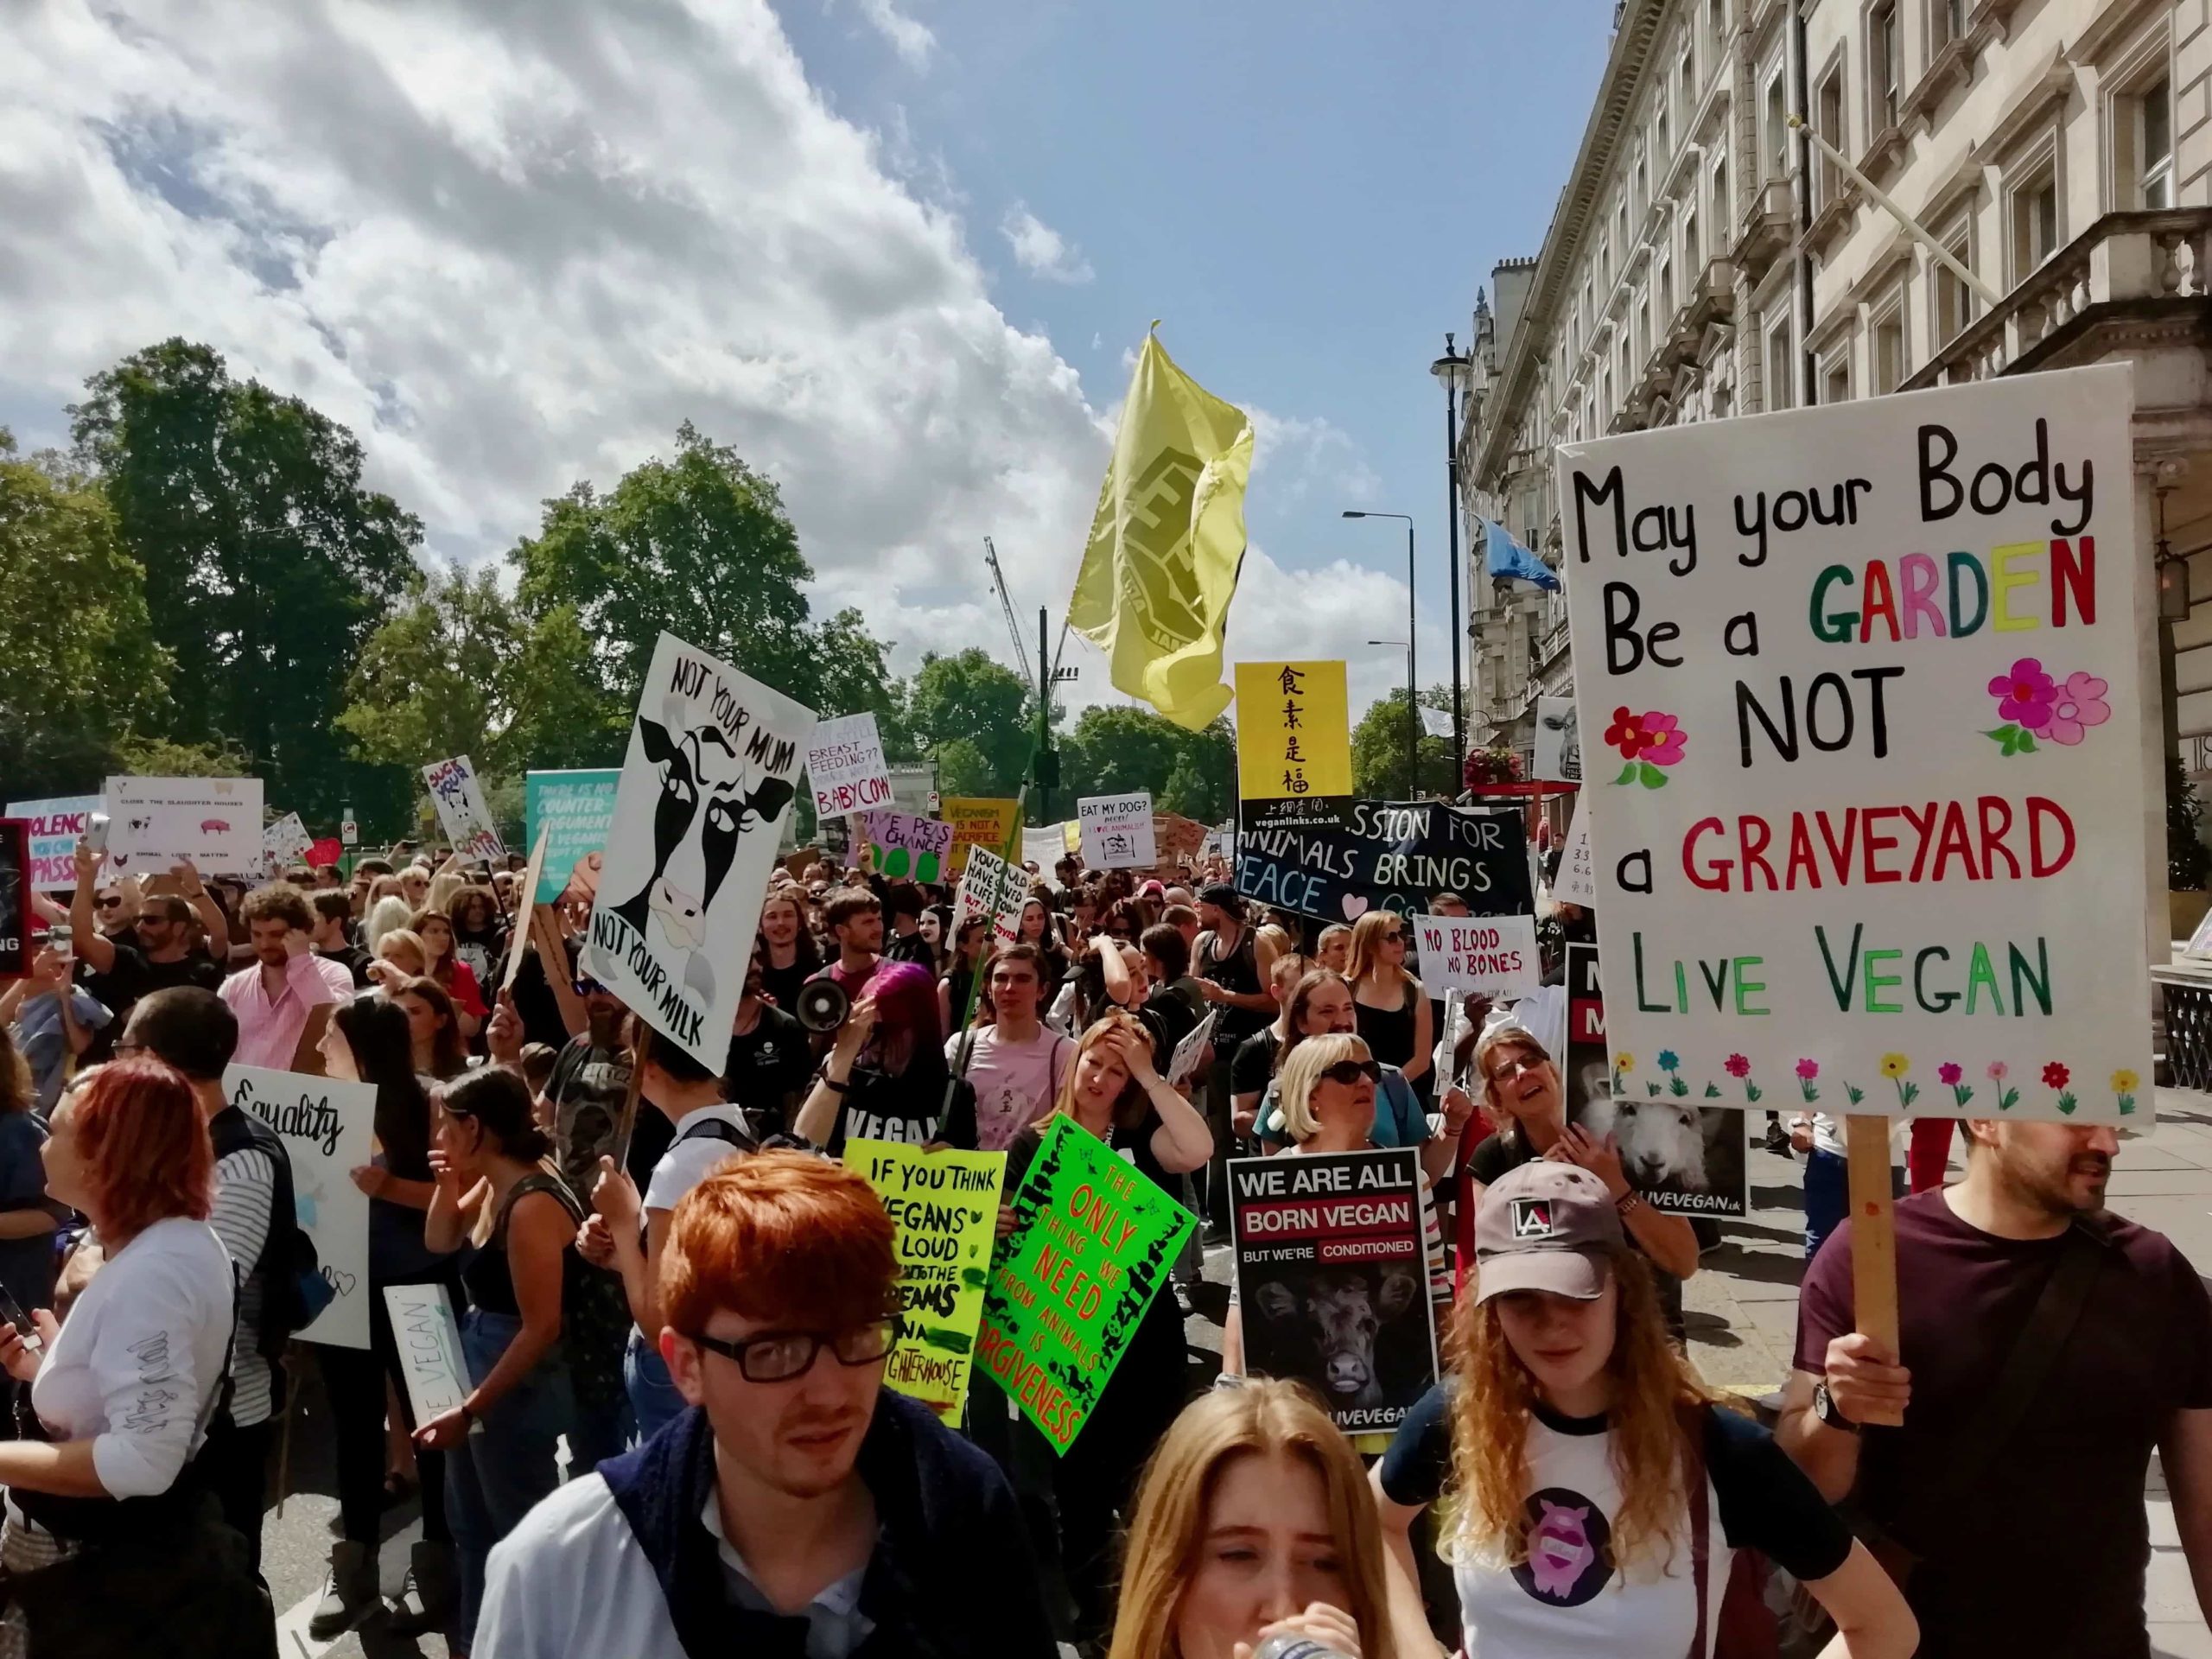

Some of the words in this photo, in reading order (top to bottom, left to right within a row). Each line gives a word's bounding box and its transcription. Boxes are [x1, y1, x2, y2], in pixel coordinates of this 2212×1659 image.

[1573, 465, 1696, 577] May
[1733, 477, 1872, 569] your
[1917, 417, 2094, 537] Body
[1602, 581, 1685, 676] Be
[1725, 611, 1760, 657] a
[1809, 535, 2096, 645] GARDEN
[671, 657, 712, 696] NOT
[710, 676, 750, 743] YOUR
[745, 730, 796, 775] MUM
[1735, 665, 1905, 767] NOT
[809, 741, 861, 762] BREAST
[810, 747, 879, 774] FEEDING??
[969, 820, 990, 830] NOT
[1081, 804, 1098, 817] EAT
[1102, 803, 1116, 815] MY
[1119, 800, 1147, 813] DOG?
[1255, 815, 1341, 829] veganlinks.co.uk
[885, 829, 945, 855] CHANCE
[912, 817, 950, 842] PEAS
[1344, 805, 1430, 842] SSION
[1447, 814, 1505, 850] FOR
[1615, 847, 1655, 896] a
[1681, 796, 2076, 894] GRAVEYARD
[967, 862, 994, 888] HAVE
[974, 848, 995, 868] YOU
[993, 860, 1027, 887] CULD
[1374, 853, 1491, 892] BRINGS
[964, 880, 972, 892] A
[973, 883, 994, 904] LIFE
[964, 893, 981, 907] BUT
[1423, 928, 1442, 951] NO
[1451, 928, 1500, 952] BLOOD
[593, 912, 629, 955] NOT
[626, 932, 666, 1001] YOUR
[659, 988, 704, 1047] MILK
[1447, 957, 1461, 974] NO
[1466, 950, 1522, 976] BONES
[234, 1079, 344, 1157] Equality
[871, 1157, 895, 1183] IF
[901, 1164, 945, 1192] YOU
[945, 1165, 997, 1192] THINK
[1104, 1165, 1137, 1201] THE
[1237, 1170, 1287, 1198] WE
[1292, 1166, 1352, 1193] ARE
[1357, 1162, 1413, 1189] ALL
[1069, 1183, 1138, 1255] ONLY
[1245, 1207, 1319, 1233] BORN
[1323, 1201, 1409, 1227] VEGAN
[902, 1234, 959, 1262] LOUD
[1038, 1206, 1088, 1255] THING
[1098, 1257, 1122, 1289] WE
[1243, 1249, 1270, 1263] BUT
[1272, 1247, 1315, 1261] WE'RE
[1323, 1240, 1414, 1257] CONDITIONED
[1033, 1243, 1103, 1320] NEED
[996, 1268, 1037, 1309] FROM
[1038, 1306, 1100, 1372] ANIMALS
[401, 1302, 447, 1386] VEGAN
[1029, 1330, 1046, 1353] IS
[888, 1348, 966, 1391] GHTERHOUSE
